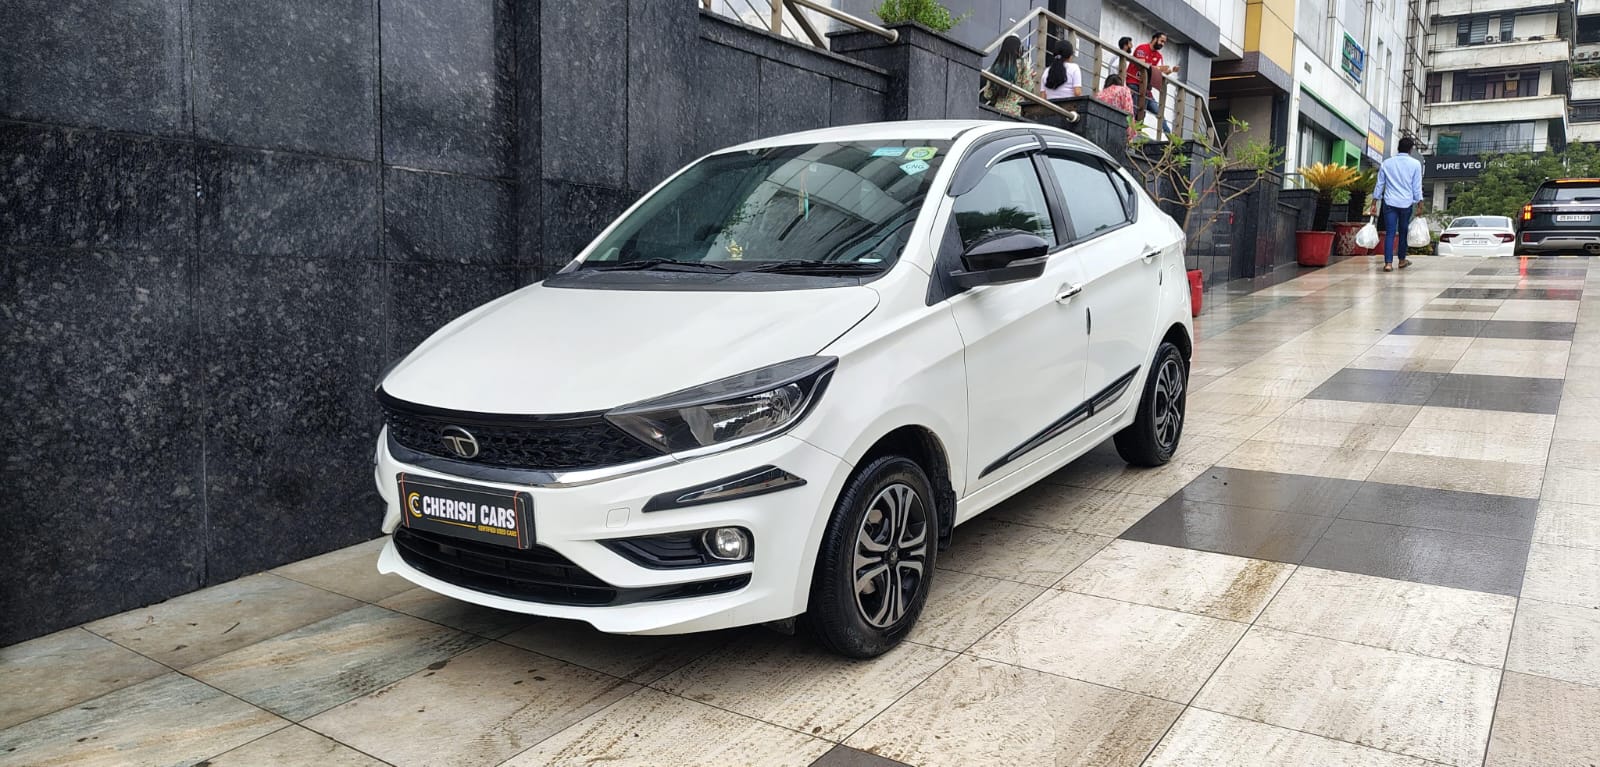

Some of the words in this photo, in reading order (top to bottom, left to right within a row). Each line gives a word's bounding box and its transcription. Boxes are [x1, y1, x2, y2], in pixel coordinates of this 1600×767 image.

[1436, 162, 1460, 170] PURE
[1463, 161, 1481, 169] VEG
[422, 495, 476, 523] CHERISH
[480, 504, 515, 529] CARS
[507, 529, 518, 537] CARS
